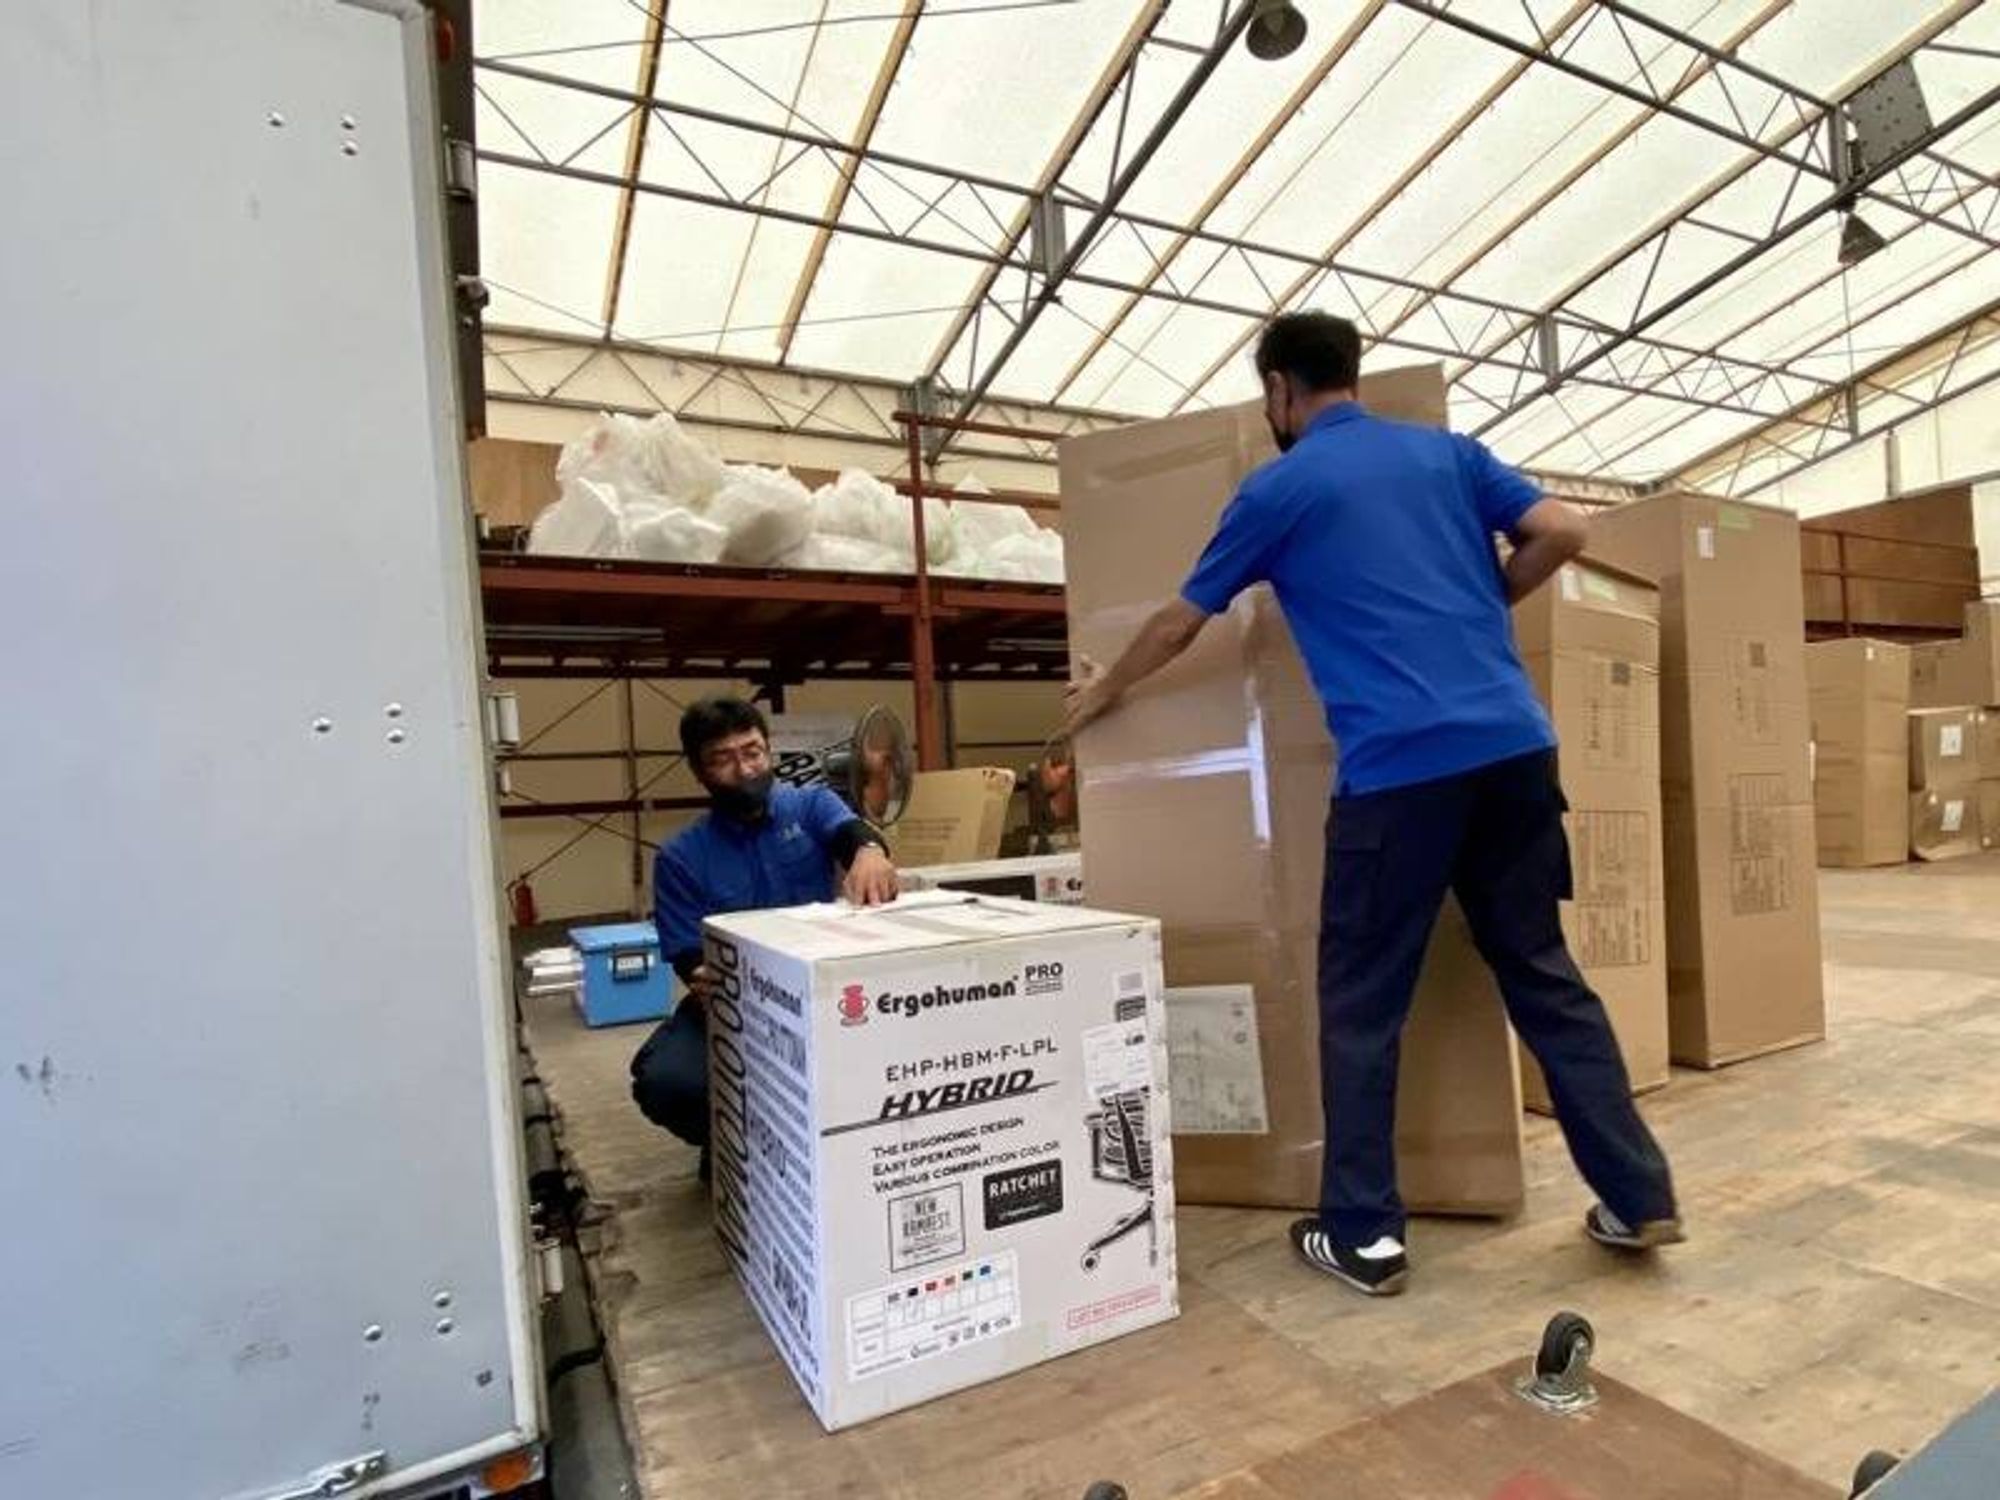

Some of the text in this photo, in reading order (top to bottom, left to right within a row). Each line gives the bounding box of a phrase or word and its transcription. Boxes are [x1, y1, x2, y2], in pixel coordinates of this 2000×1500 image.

[877, 980, 1016, 1017] Ergohuman
[1025, 962, 1063, 981] PRO
[880, 1068, 1035, 1119] HYBRID
[873, 1117, 1024, 1159] THE ERGONOMIC DESIGN
[873, 1143, 982, 1176] EASY OPERATION
[873, 1141, 1061, 1193] VARIOUS COMBINATION COLOR
[989, 1169, 1057, 1199] RATCHET
